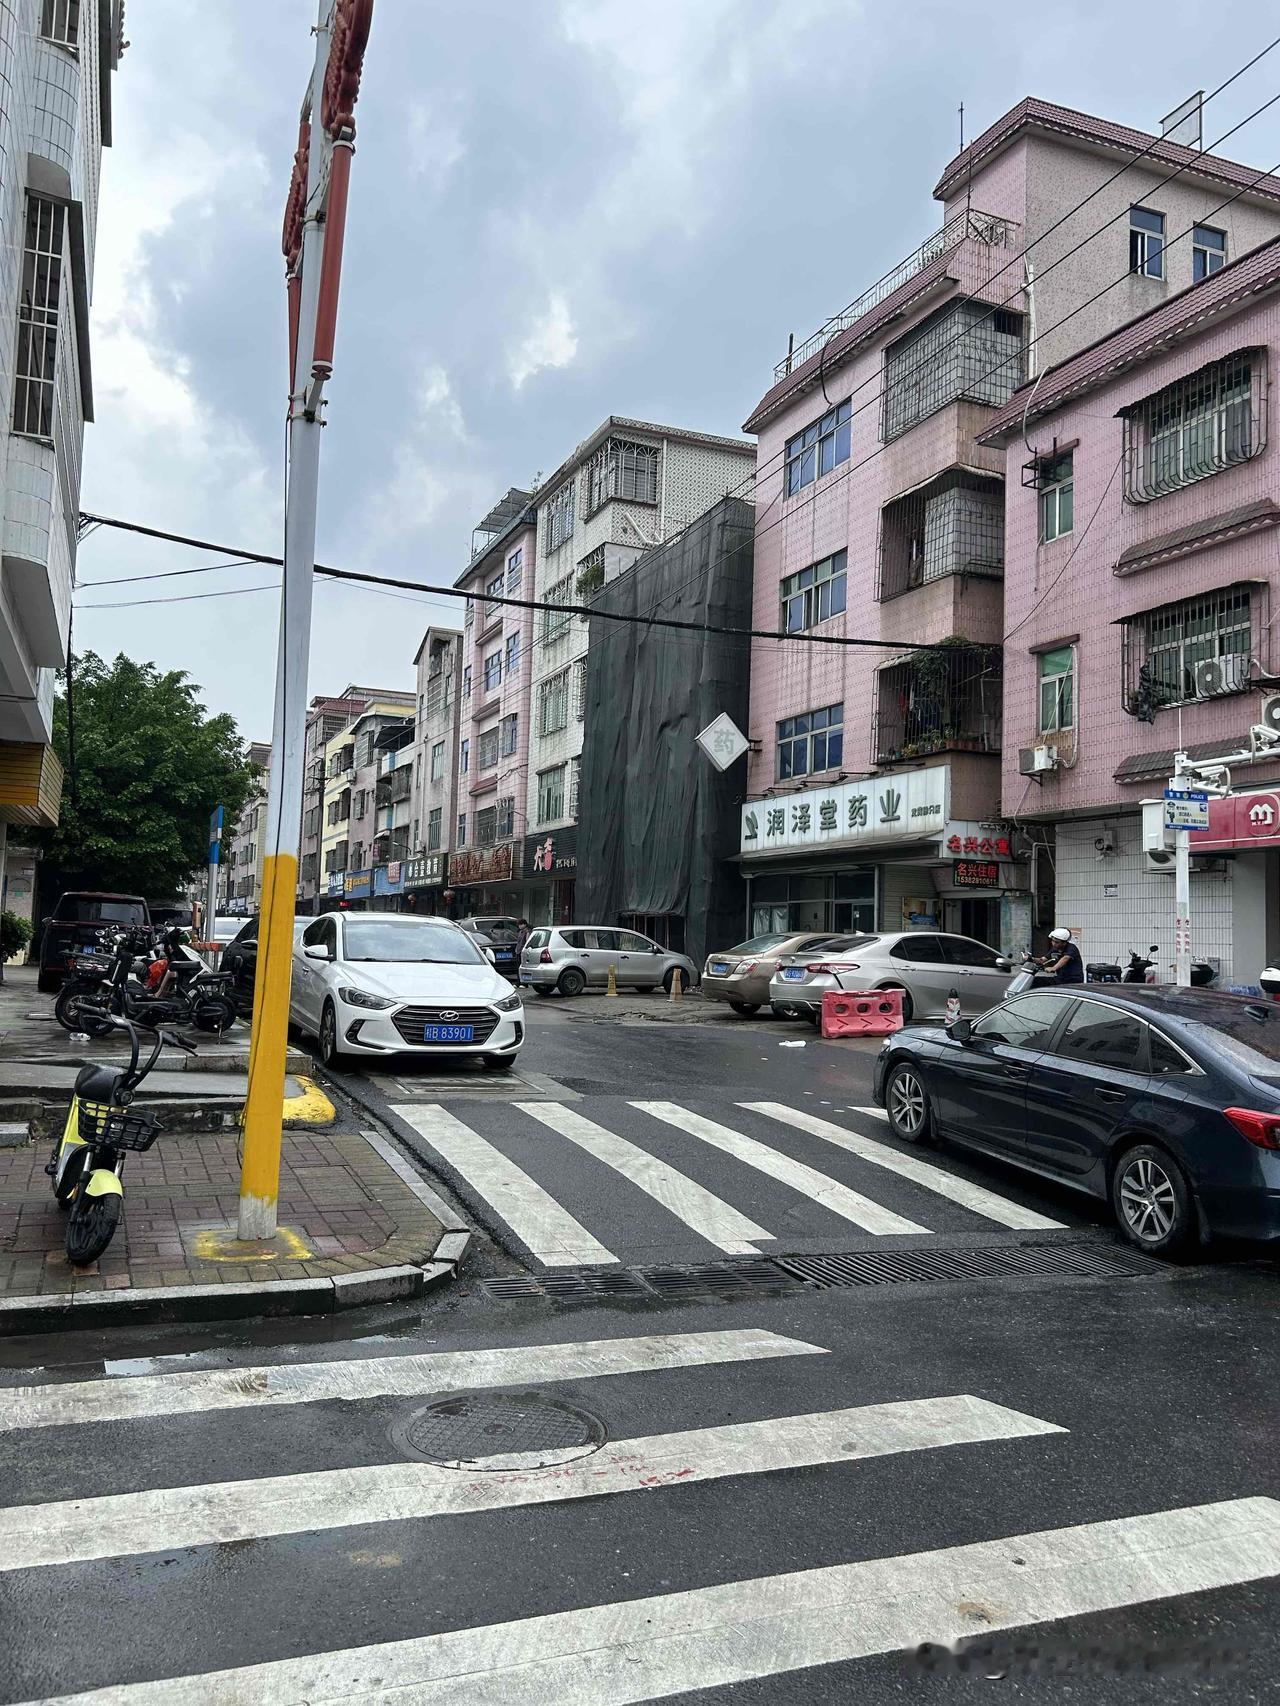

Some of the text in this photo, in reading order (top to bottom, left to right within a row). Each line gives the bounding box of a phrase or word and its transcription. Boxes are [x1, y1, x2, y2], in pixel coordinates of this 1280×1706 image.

[713, 729, 735, 754] 药
[766, 788, 901, 837] 润泽堂药业
[947, 834, 1009, 856] 名兴公寓
